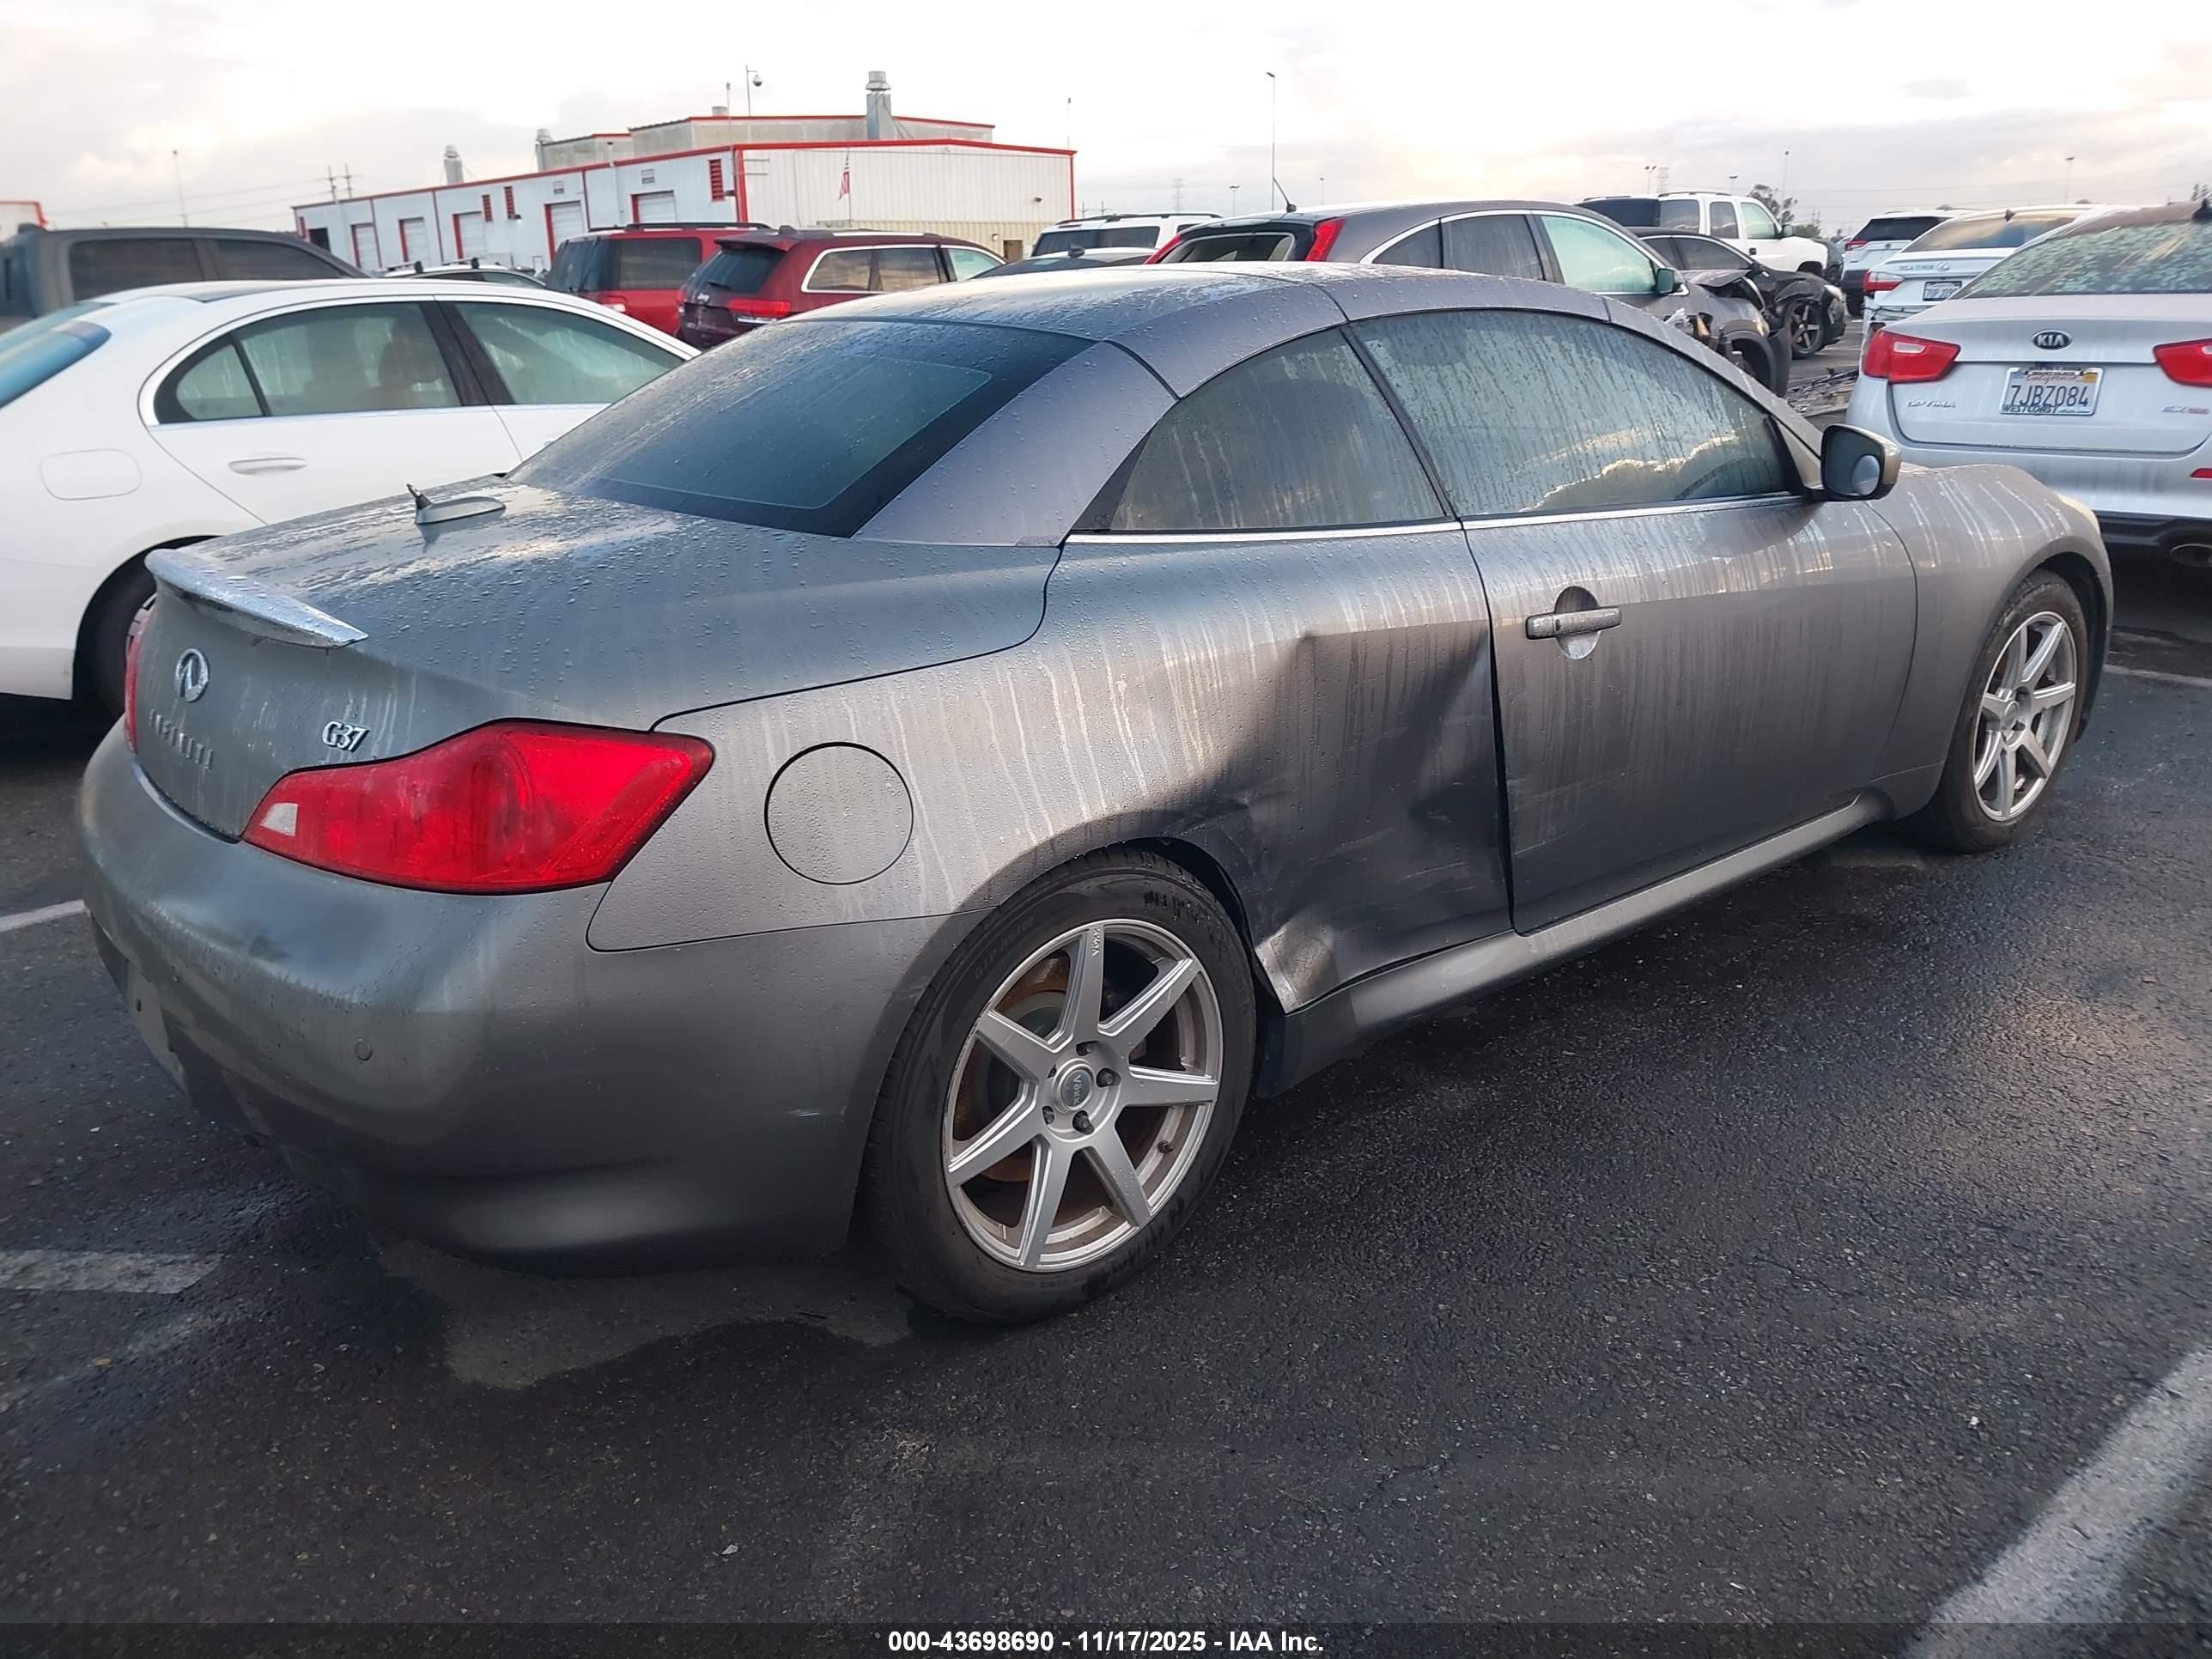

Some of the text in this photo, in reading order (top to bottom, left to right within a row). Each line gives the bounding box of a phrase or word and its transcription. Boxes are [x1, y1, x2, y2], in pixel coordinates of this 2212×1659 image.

[2037, 334, 2064, 346] KIA
[2009, 385, 2090, 407] 7JBZ084
[322, 720, 370, 752] G37
